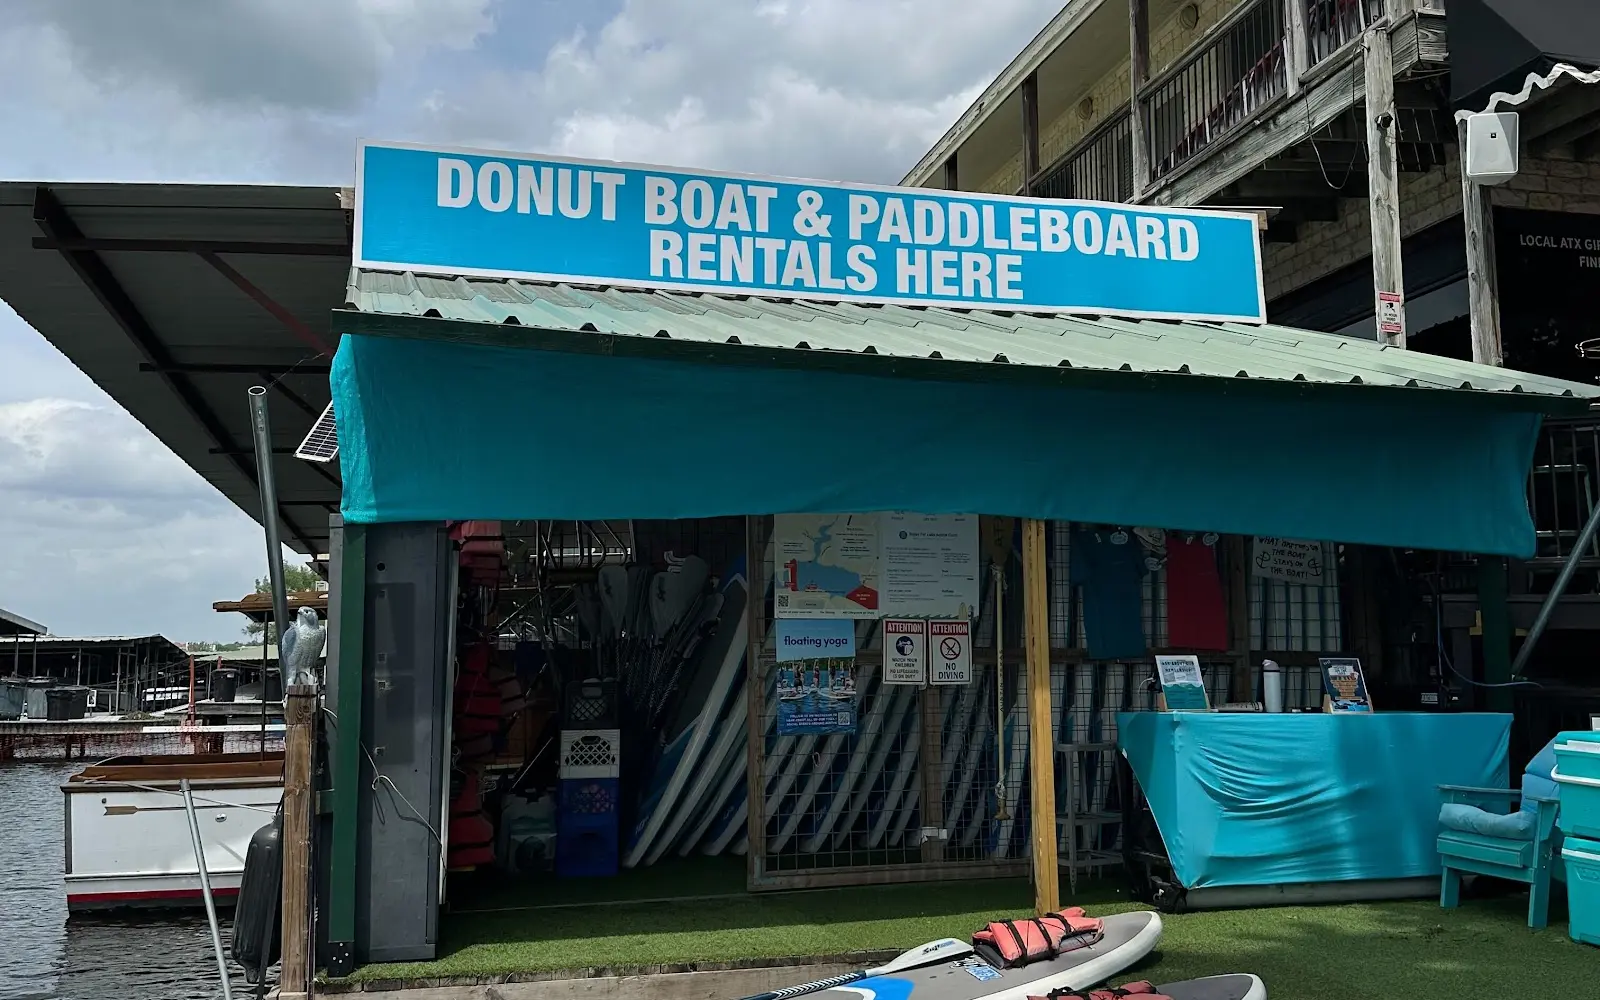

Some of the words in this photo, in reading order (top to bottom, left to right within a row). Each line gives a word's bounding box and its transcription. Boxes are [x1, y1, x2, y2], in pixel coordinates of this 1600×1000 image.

[437, 157, 626, 221] DONUT
[644, 175, 778, 233] BOAT
[793, 190, 832, 238] &
[848, 193, 1200, 262] PADDLEBOARD
[1519, 234, 1558, 248] LOCAL
[1560, 237, 1582, 250] ATX
[649, 229, 878, 292] RENTALS
[896, 248, 1024, 300] HERE
[1259, 536, 1280, 546] WHAT
[1287, 551, 1306, 559] BOAT
[1274, 559, 1293, 567] STAYS
[1270, 567, 1283, 575] THE
[1286, 569, 1308, 579] BOAT!
[887, 622, 922, 633] ATTENTION
[932, 623, 968, 634] ATTENTION
[784, 636, 821, 648] floating
[823, 638, 848, 648] yoga
